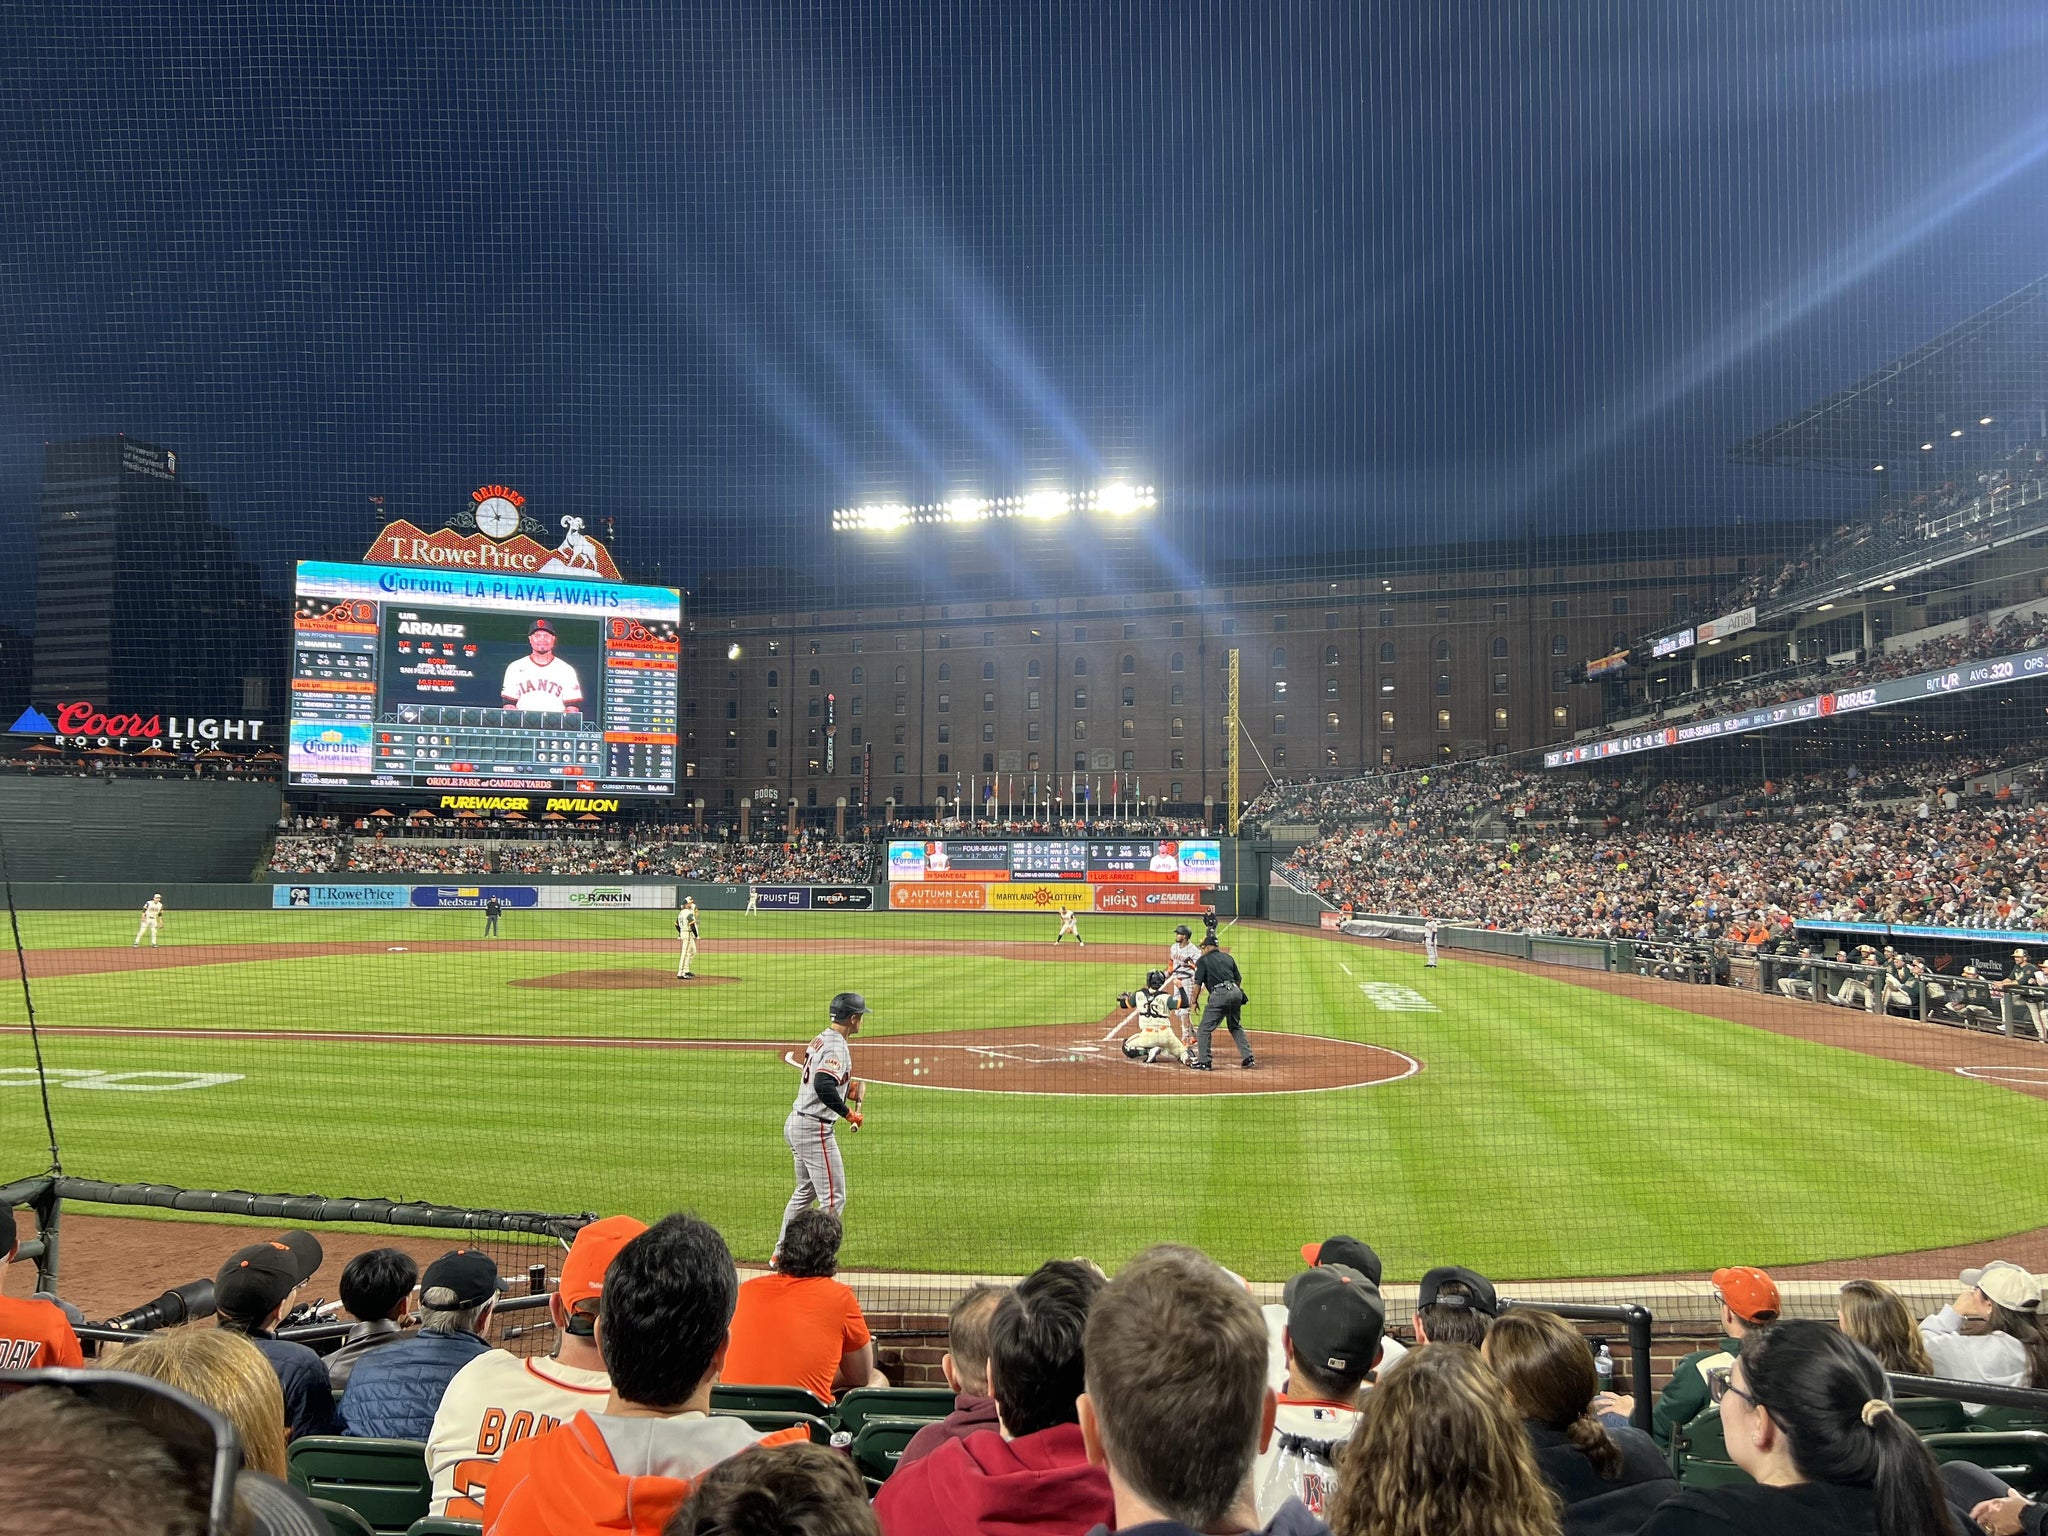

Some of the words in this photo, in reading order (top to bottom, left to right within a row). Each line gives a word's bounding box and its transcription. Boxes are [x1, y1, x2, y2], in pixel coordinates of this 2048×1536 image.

[472, 484, 525, 506] ORIOLES
[378, 571, 453, 595] Corona
[465, 580, 486, 598] LA
[493, 583, 546, 603] PLAYA
[553, 587, 620, 608] AWAITS
[398, 612, 418, 620] LUIS
[398, 621, 465, 637] ARRAEZ
[1926, 677, 1940, 691] B/T
[1941, 672, 1960, 690] L/R
[1970, 668, 1988, 681] AVG
[1990, 661, 2013, 680] .320
[2024, 657, 2044, 671] OPS
[1836, 689, 1876, 710] ARRAEZ
[56, 702, 163, 737] Coors
[168, 717, 264, 741] LIGHT
[1678, 724, 1711, 740] FOUR-SEAM
[1712, 722, 1720, 733] FB
[1724, 719, 1739, 731] 95.8
[54, 735, 128, 748] ROOF
[152, 738, 219, 751] DECK
[303, 739, 358, 754] Corona
[416, 735, 425, 744] 0
[430, 736, 438, 745] 0
[444, 736, 451, 745] 1
[539, 740, 545, 749] 1
[550, 741, 558, 749] 2
[563, 741, 571, 749] 0
[579, 741, 586, 750] 4
[591, 742, 598, 751] 2
[1580, 748, 1588, 759] SF
[1594, 746, 1598, 756] 1
[1608, 742, 1620, 753] BAL
[1623, 740, 1628, 750] 0
[416, 749, 425, 757] 0
[429, 749, 438, 758] 0
[538, 753, 546, 761] 0
[550, 753, 558, 761] 2
[563, 754, 570, 762] 0
[578, 754, 586, 763] 4
[590, 755, 598, 763] 2
[426, 777, 458, 786] ORIOLE
[458, 778, 480, 787] PARK
[490, 779, 525, 788] CAMDEN
[526, 780, 552, 789] YARDS
[440, 795, 529, 810] PUREWAGER
[545, 798, 618, 812] PAVILION
[893, 856, 920, 865] Corona
[1183, 857, 1215, 867] Corona
[758, 894, 787, 902] TRUIST
[911, 889, 952, 898] AUTUMN
[955, 890, 980, 898] LAKE
[996, 893, 1034, 901] MARYLAND
[1103, 894, 1138, 908] HIGH'S
[438, 898, 478, 906] MedStar
[480, 898, 511, 906] Hlth
